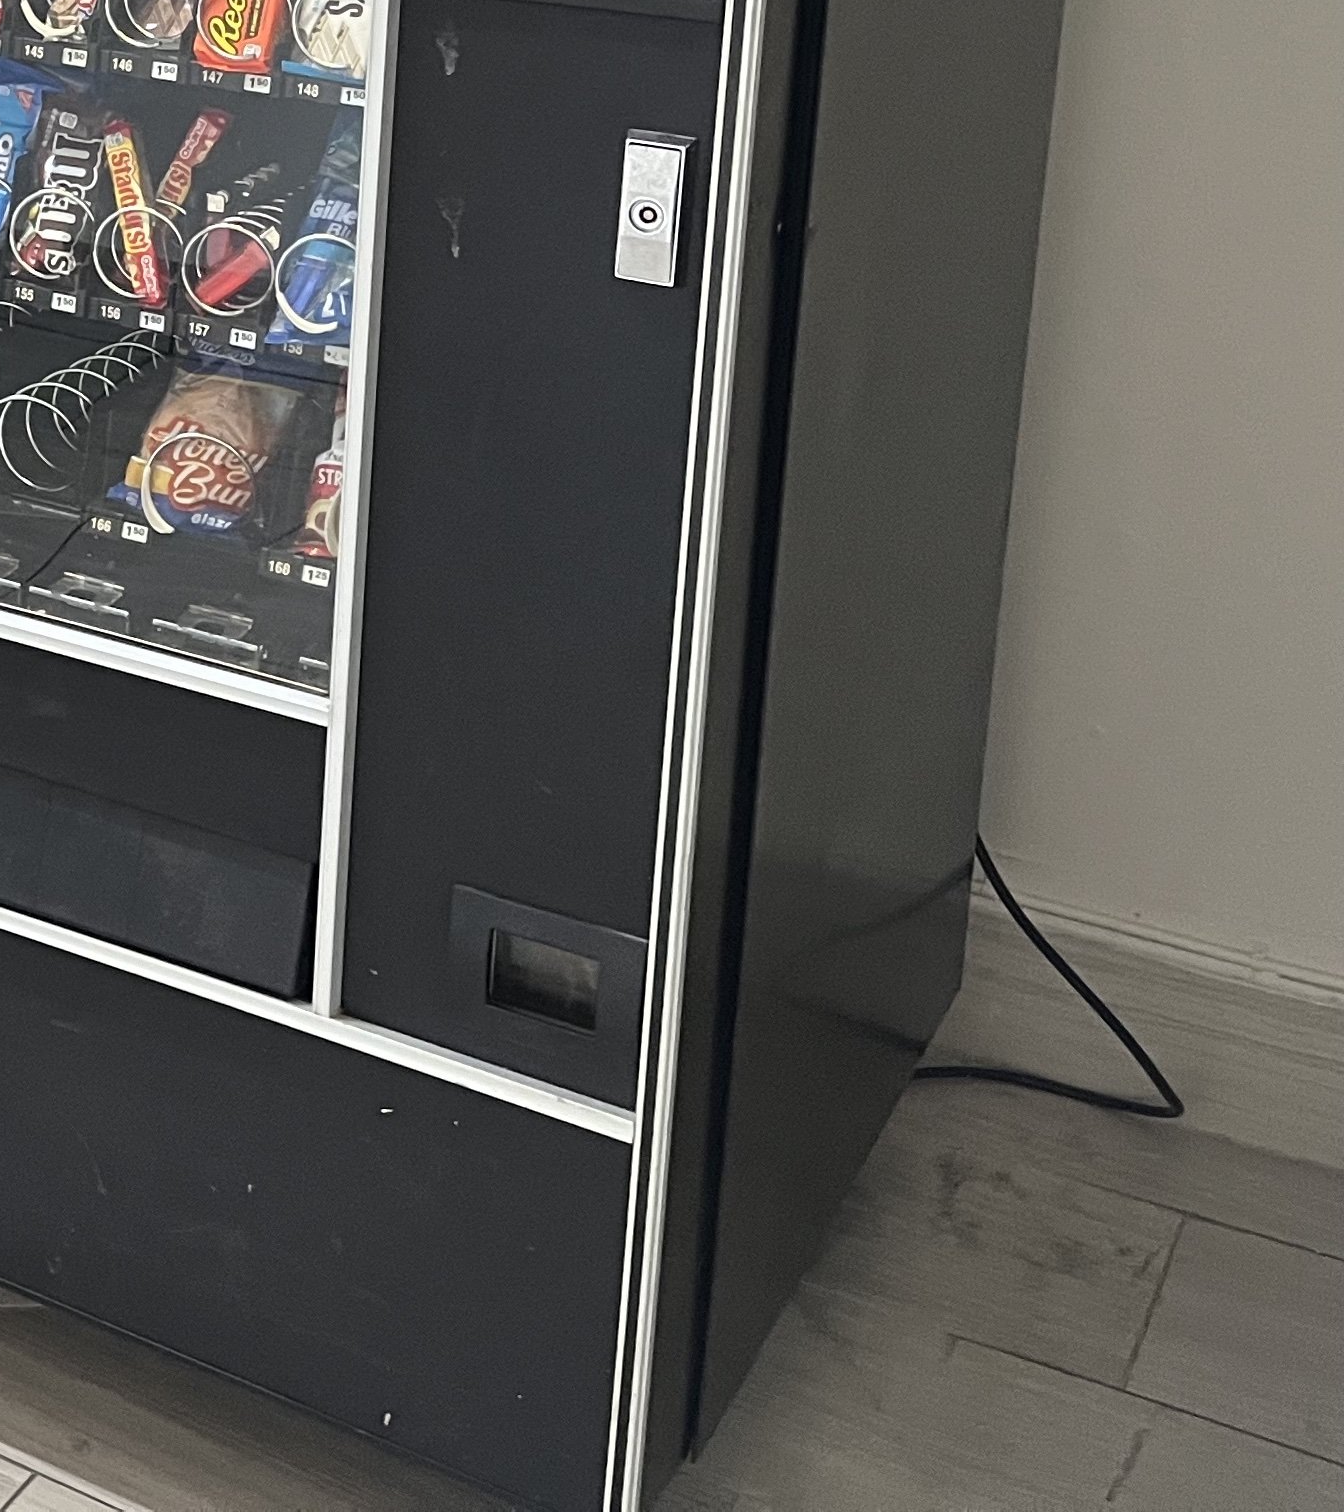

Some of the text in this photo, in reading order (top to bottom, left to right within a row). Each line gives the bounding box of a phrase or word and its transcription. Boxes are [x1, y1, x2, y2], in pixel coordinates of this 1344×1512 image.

[24, 44, 44, 59] 145
[111, 57, 133, 72] 146
[201, 69, 224, 85] 147
[297, 82, 320, 98] 148
[111, 150, 150, 254] Starburst
[310, 198, 358, 226] Gille
[14, 286, 34, 302] 155
[100, 305, 122, 320] 156
[188, 321, 211, 337] 157
[148, 420, 269, 485] Honey
[173, 460, 252, 508] Bun
[90, 516, 112, 533] 166
[267, 559, 291, 576] 168
